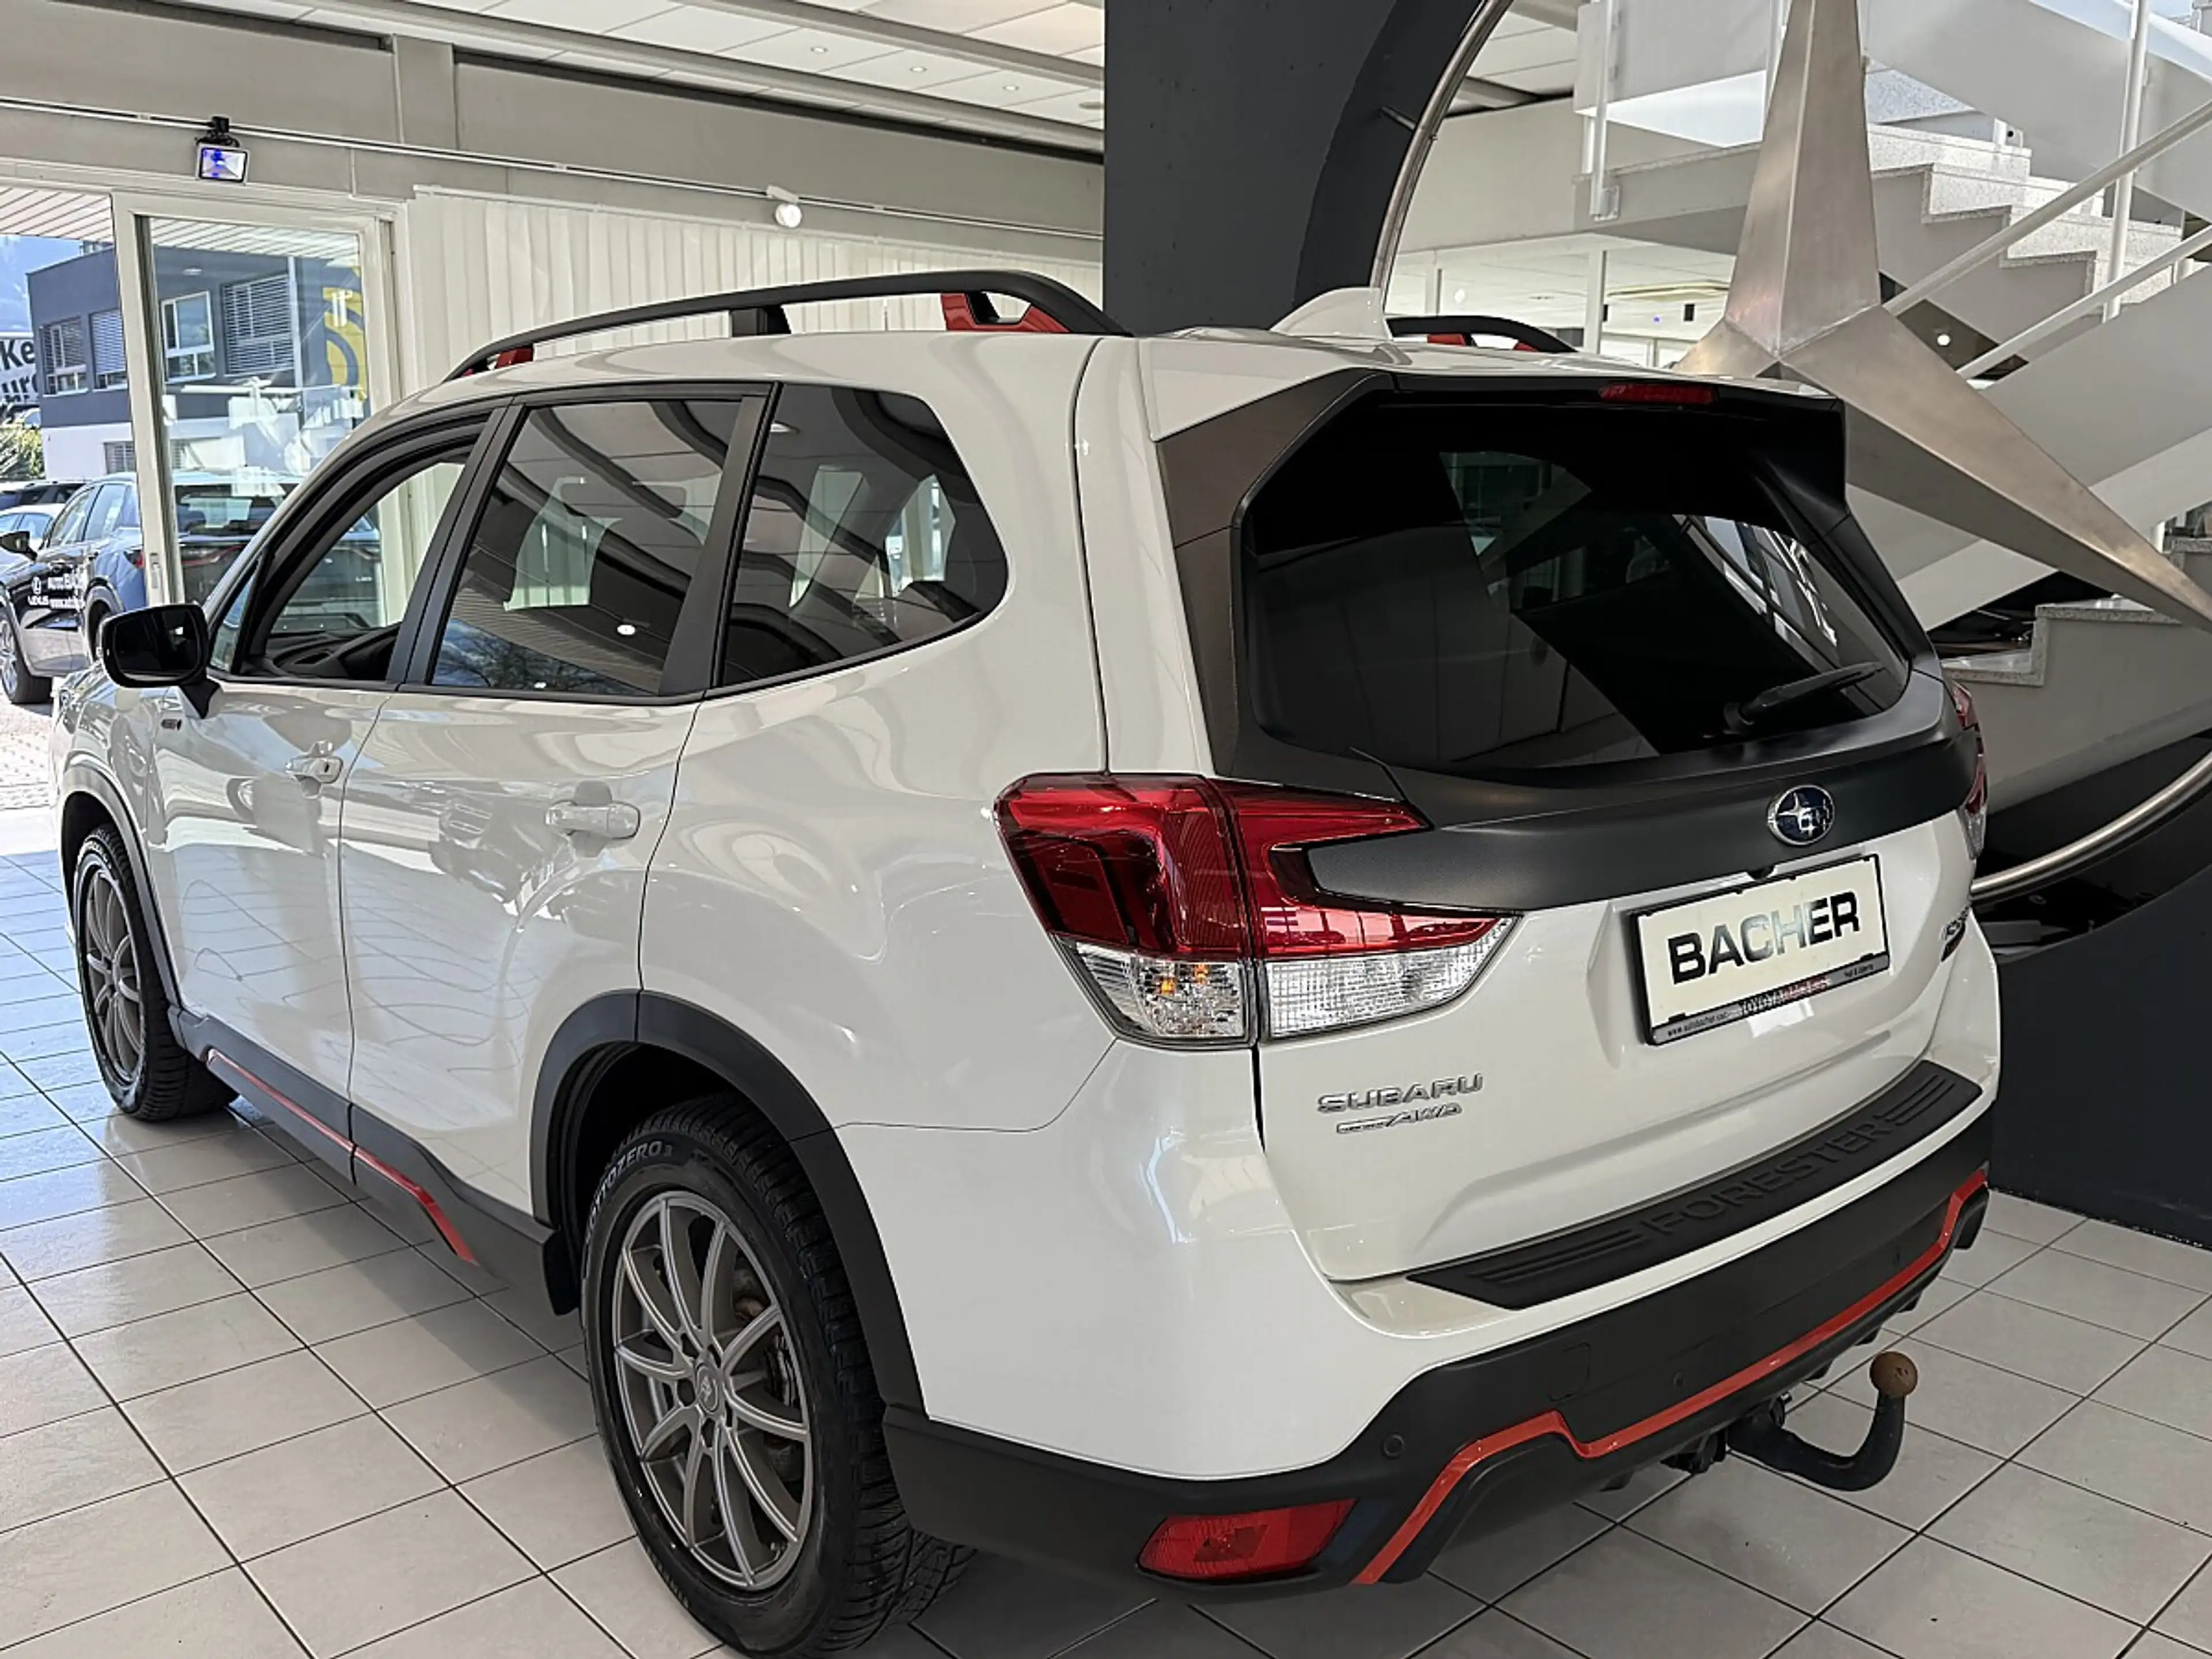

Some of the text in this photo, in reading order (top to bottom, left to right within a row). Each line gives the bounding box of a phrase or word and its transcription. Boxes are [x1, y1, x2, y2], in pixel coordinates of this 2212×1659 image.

[1668, 891, 1860, 984] BACHER
[1317, 1073, 1483, 1113] SUBARU
[1641, 1122, 1893, 1236] FORESTER
